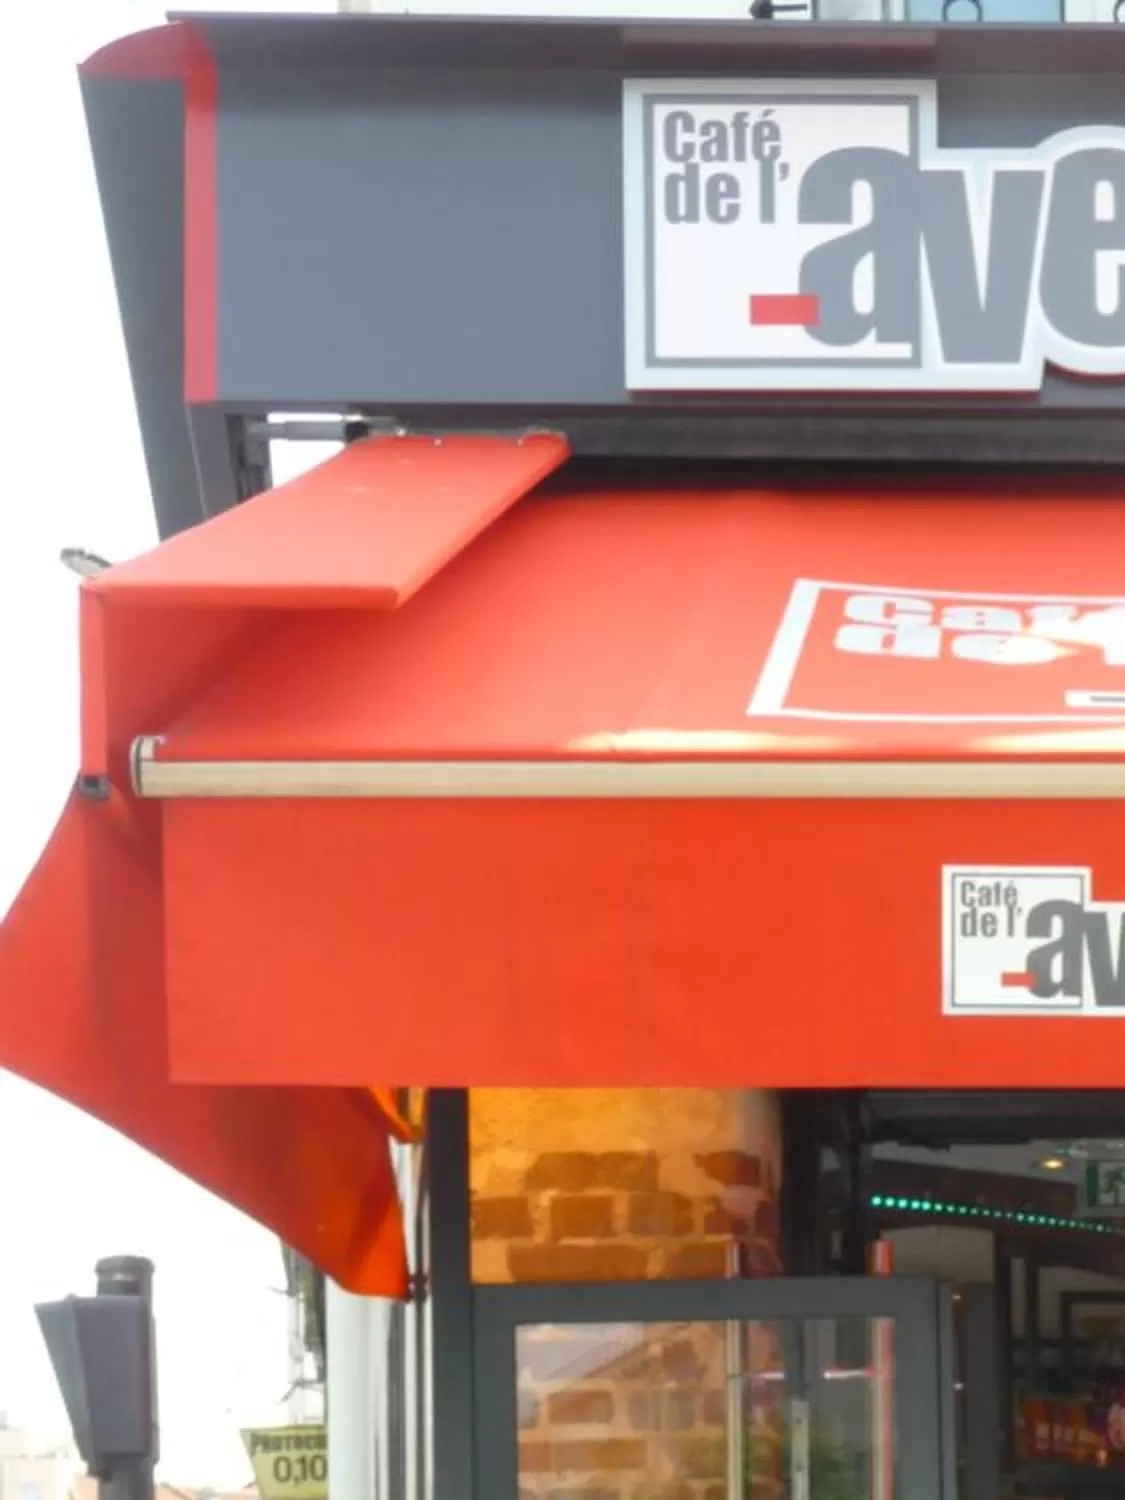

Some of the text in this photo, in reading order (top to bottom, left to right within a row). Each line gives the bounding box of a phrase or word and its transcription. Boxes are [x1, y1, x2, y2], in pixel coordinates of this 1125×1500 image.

[663, 108, 782, 164] Café
[663, 162, 741, 225] de
[960, 879, 1018, 908] Café
[960, 905, 998, 938] de
[272, 1454, 328, 1488] 0,10
